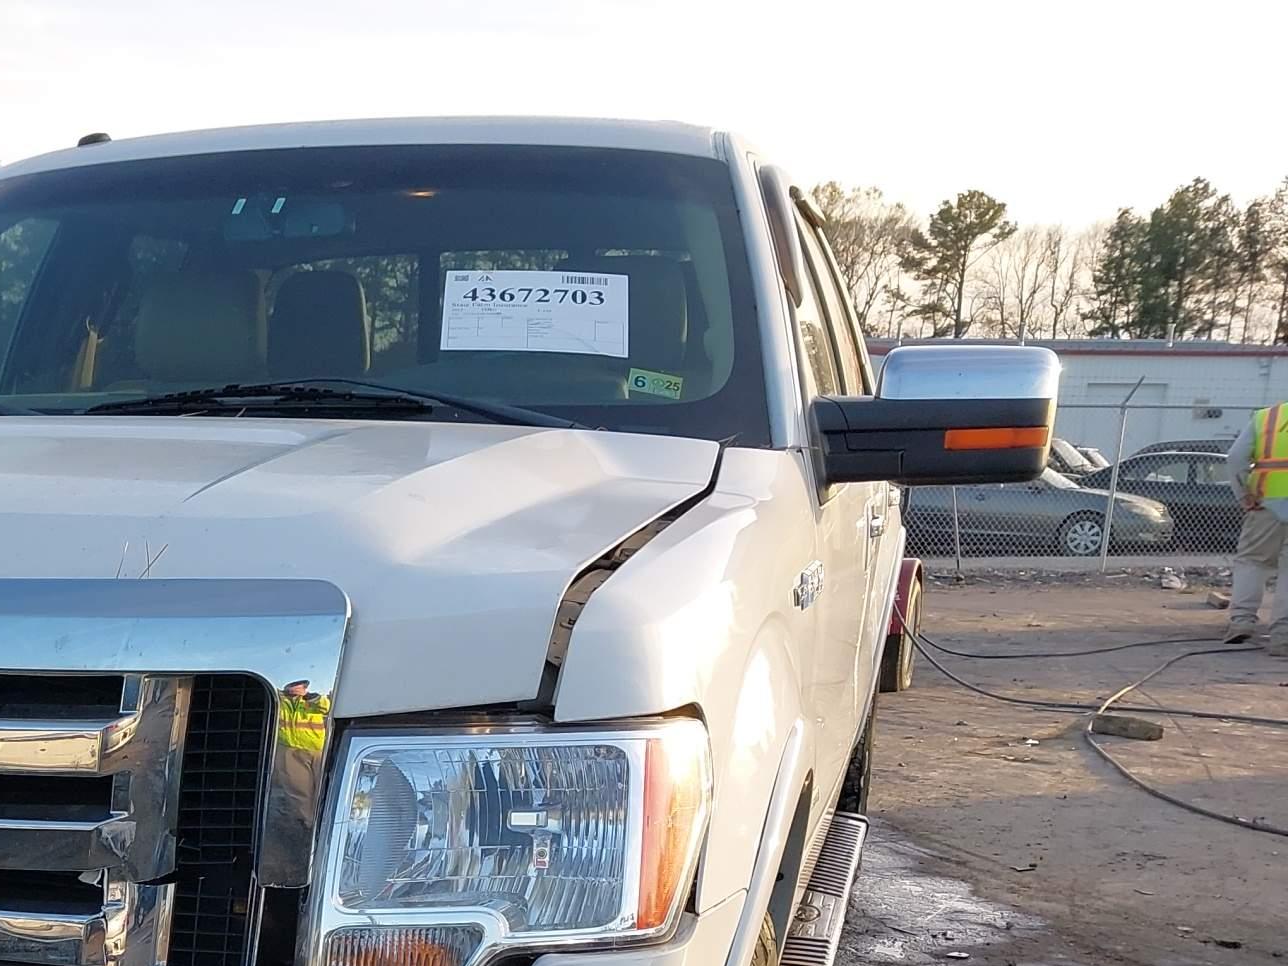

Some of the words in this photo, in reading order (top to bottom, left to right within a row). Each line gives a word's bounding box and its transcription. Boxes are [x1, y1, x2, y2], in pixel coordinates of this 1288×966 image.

[463, 287, 605, 305] 43672703
[634, 375, 647, 388] 6
[664, 380, 681, 392] 25
